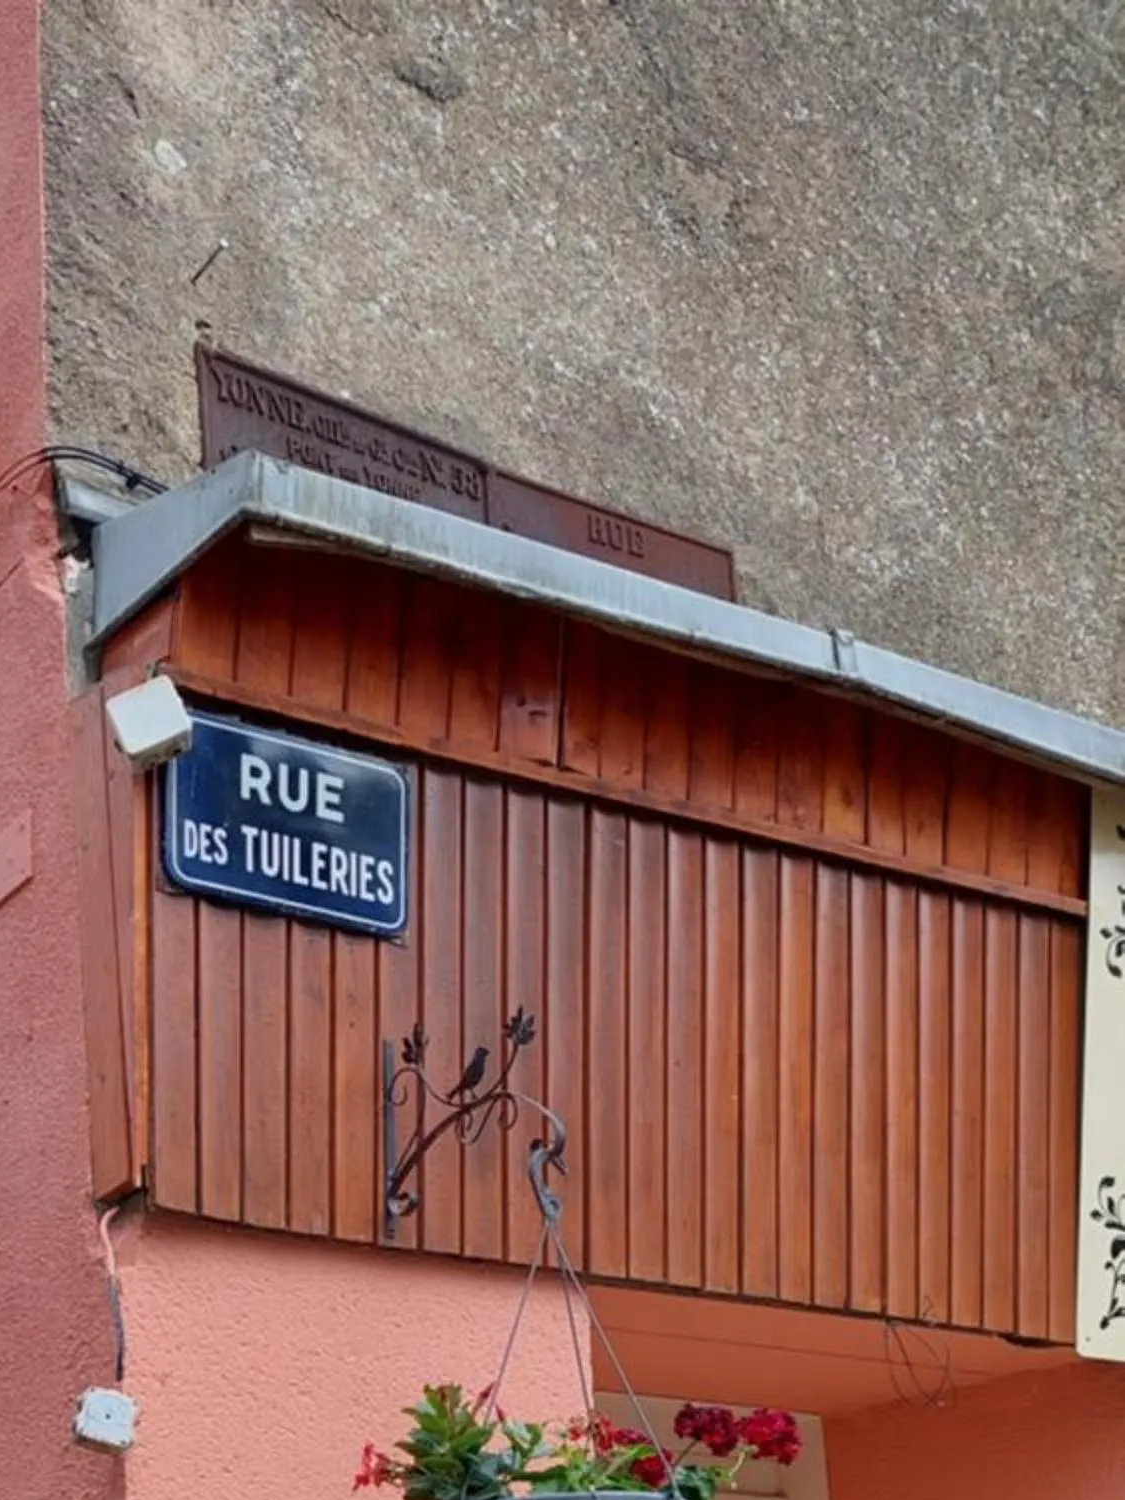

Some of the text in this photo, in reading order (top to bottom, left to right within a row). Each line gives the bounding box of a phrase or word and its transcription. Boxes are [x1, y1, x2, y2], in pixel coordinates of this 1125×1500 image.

[586, 513, 645, 558] RUE
[240, 752, 346, 823] RUE
[183, 818, 395, 906] DES TUILERIES
